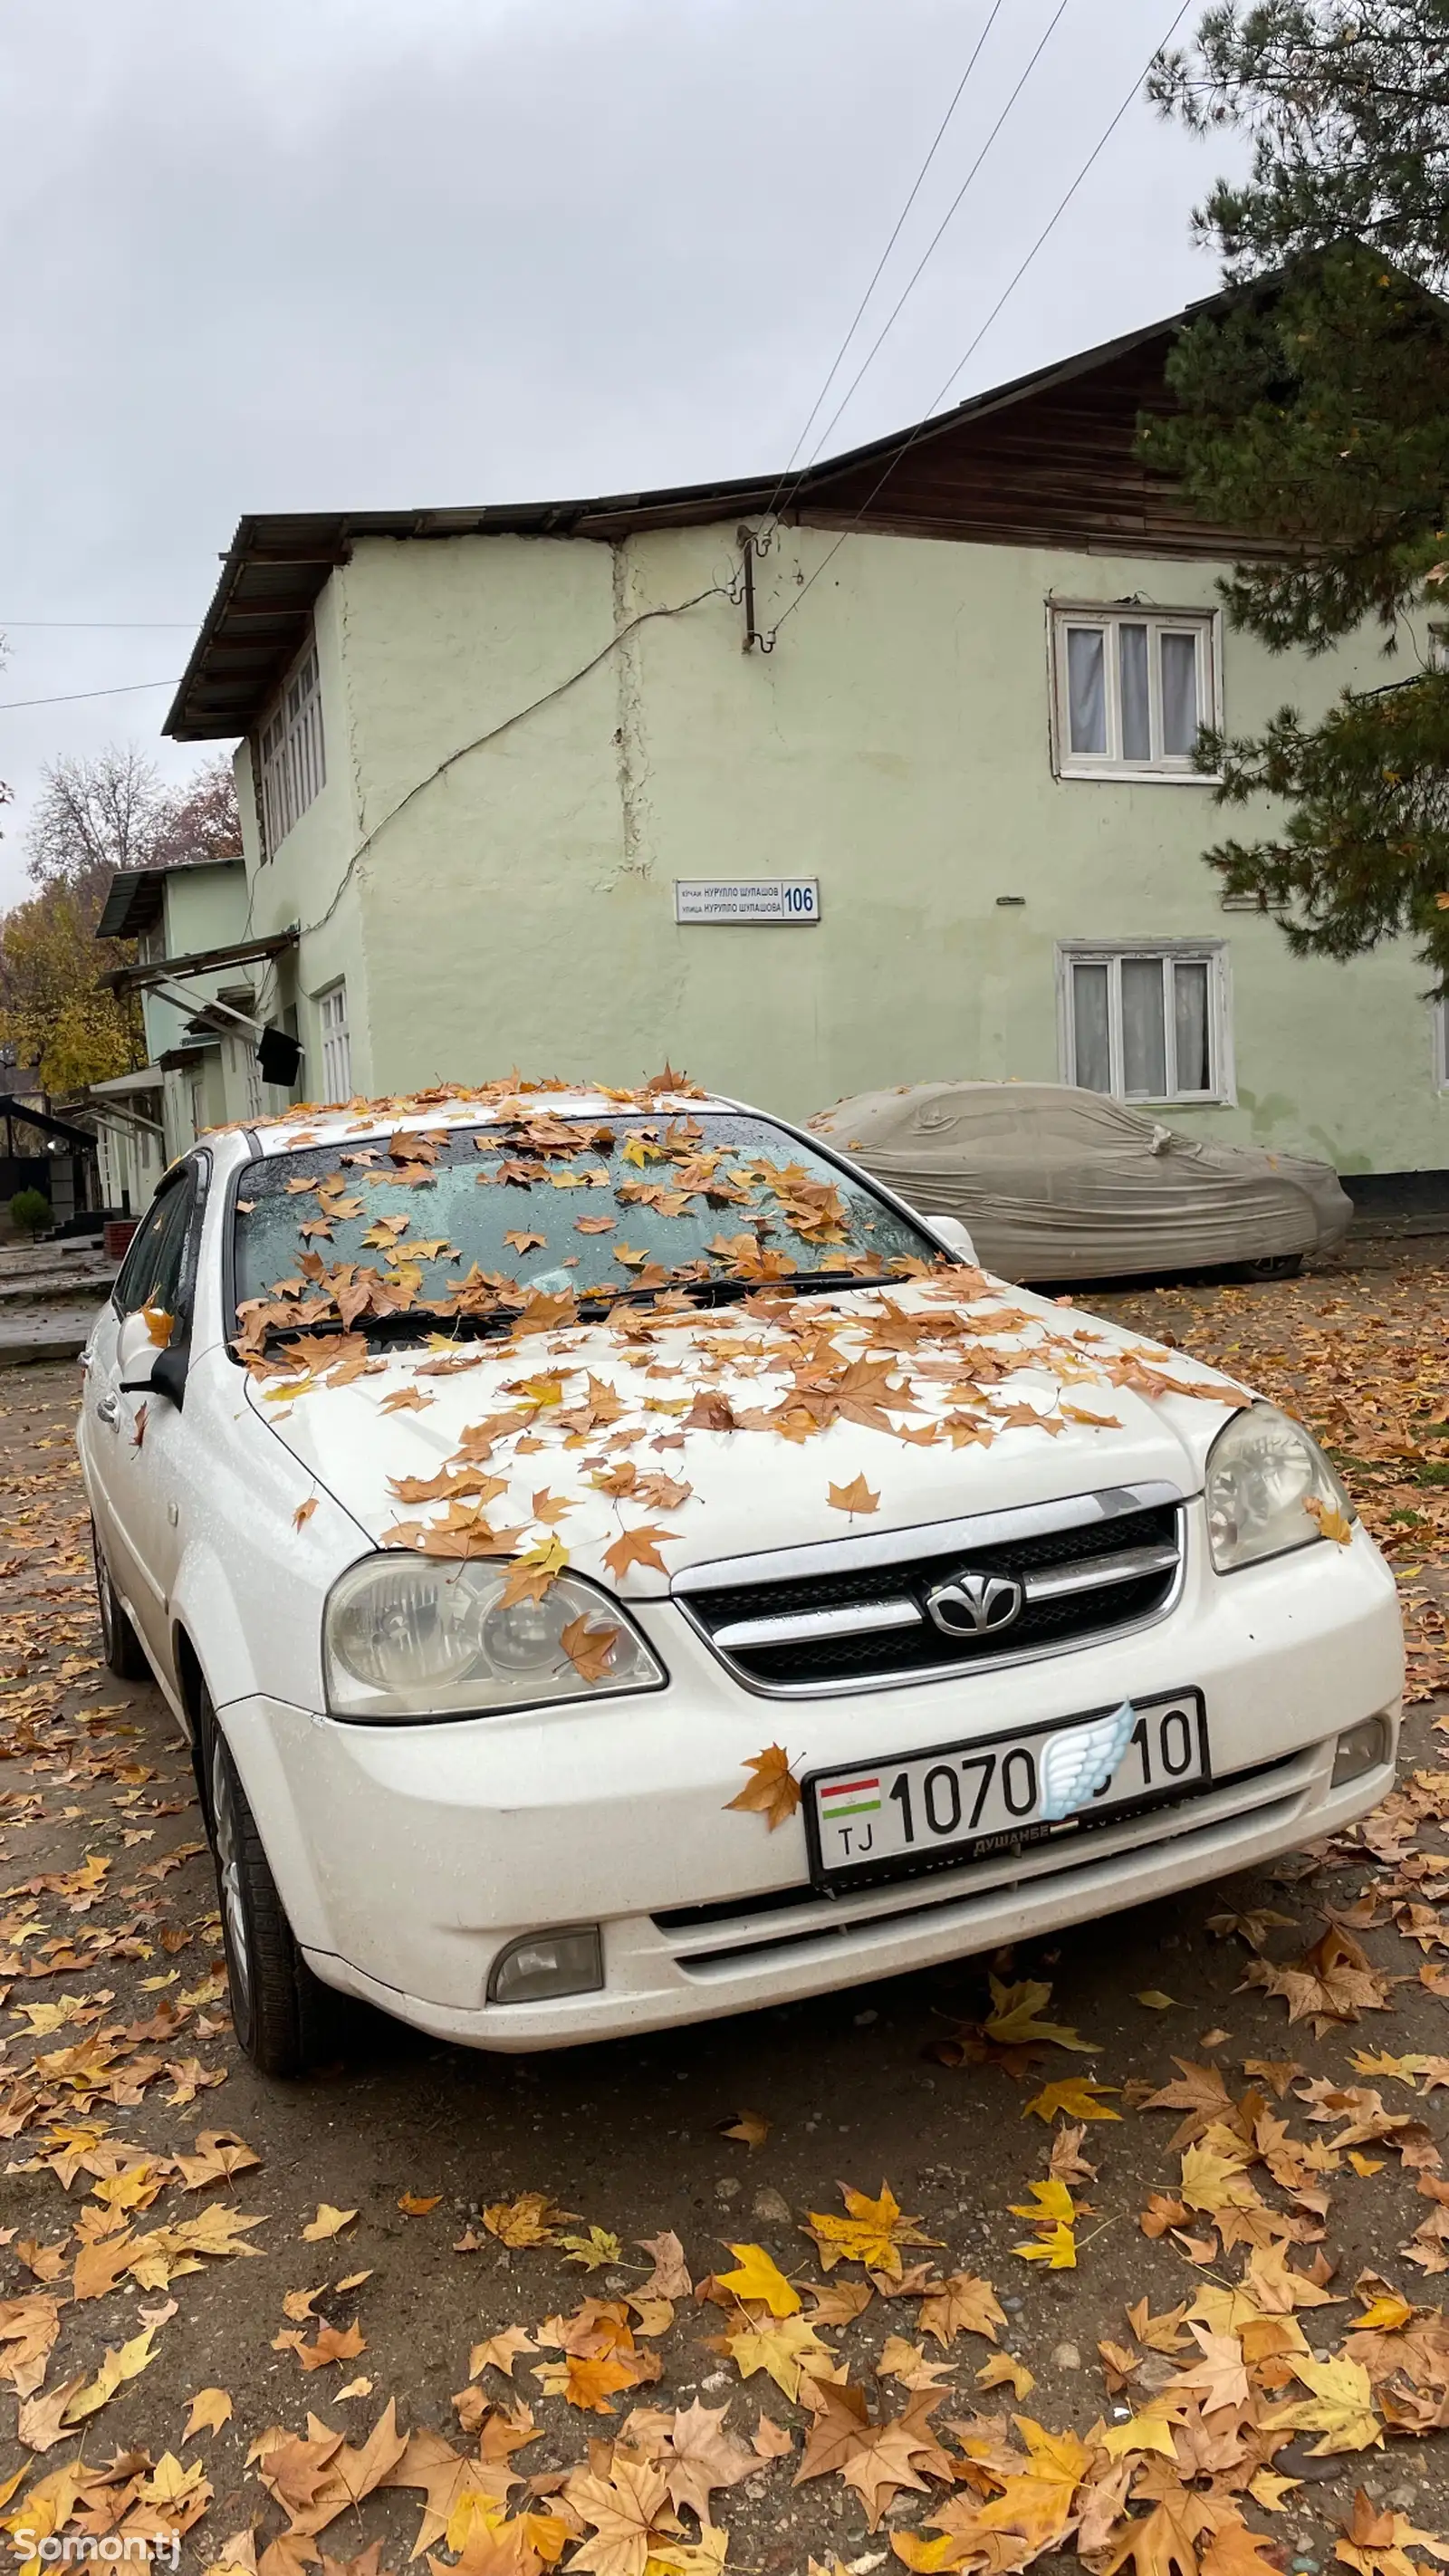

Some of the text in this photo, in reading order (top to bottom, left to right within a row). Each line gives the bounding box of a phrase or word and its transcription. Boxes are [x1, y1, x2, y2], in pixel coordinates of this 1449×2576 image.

[784, 887, 813, 912] 106
[838, 1824, 873, 1855] TJ
[973, 1824, 1051, 1857] ДУШАНБЕ
